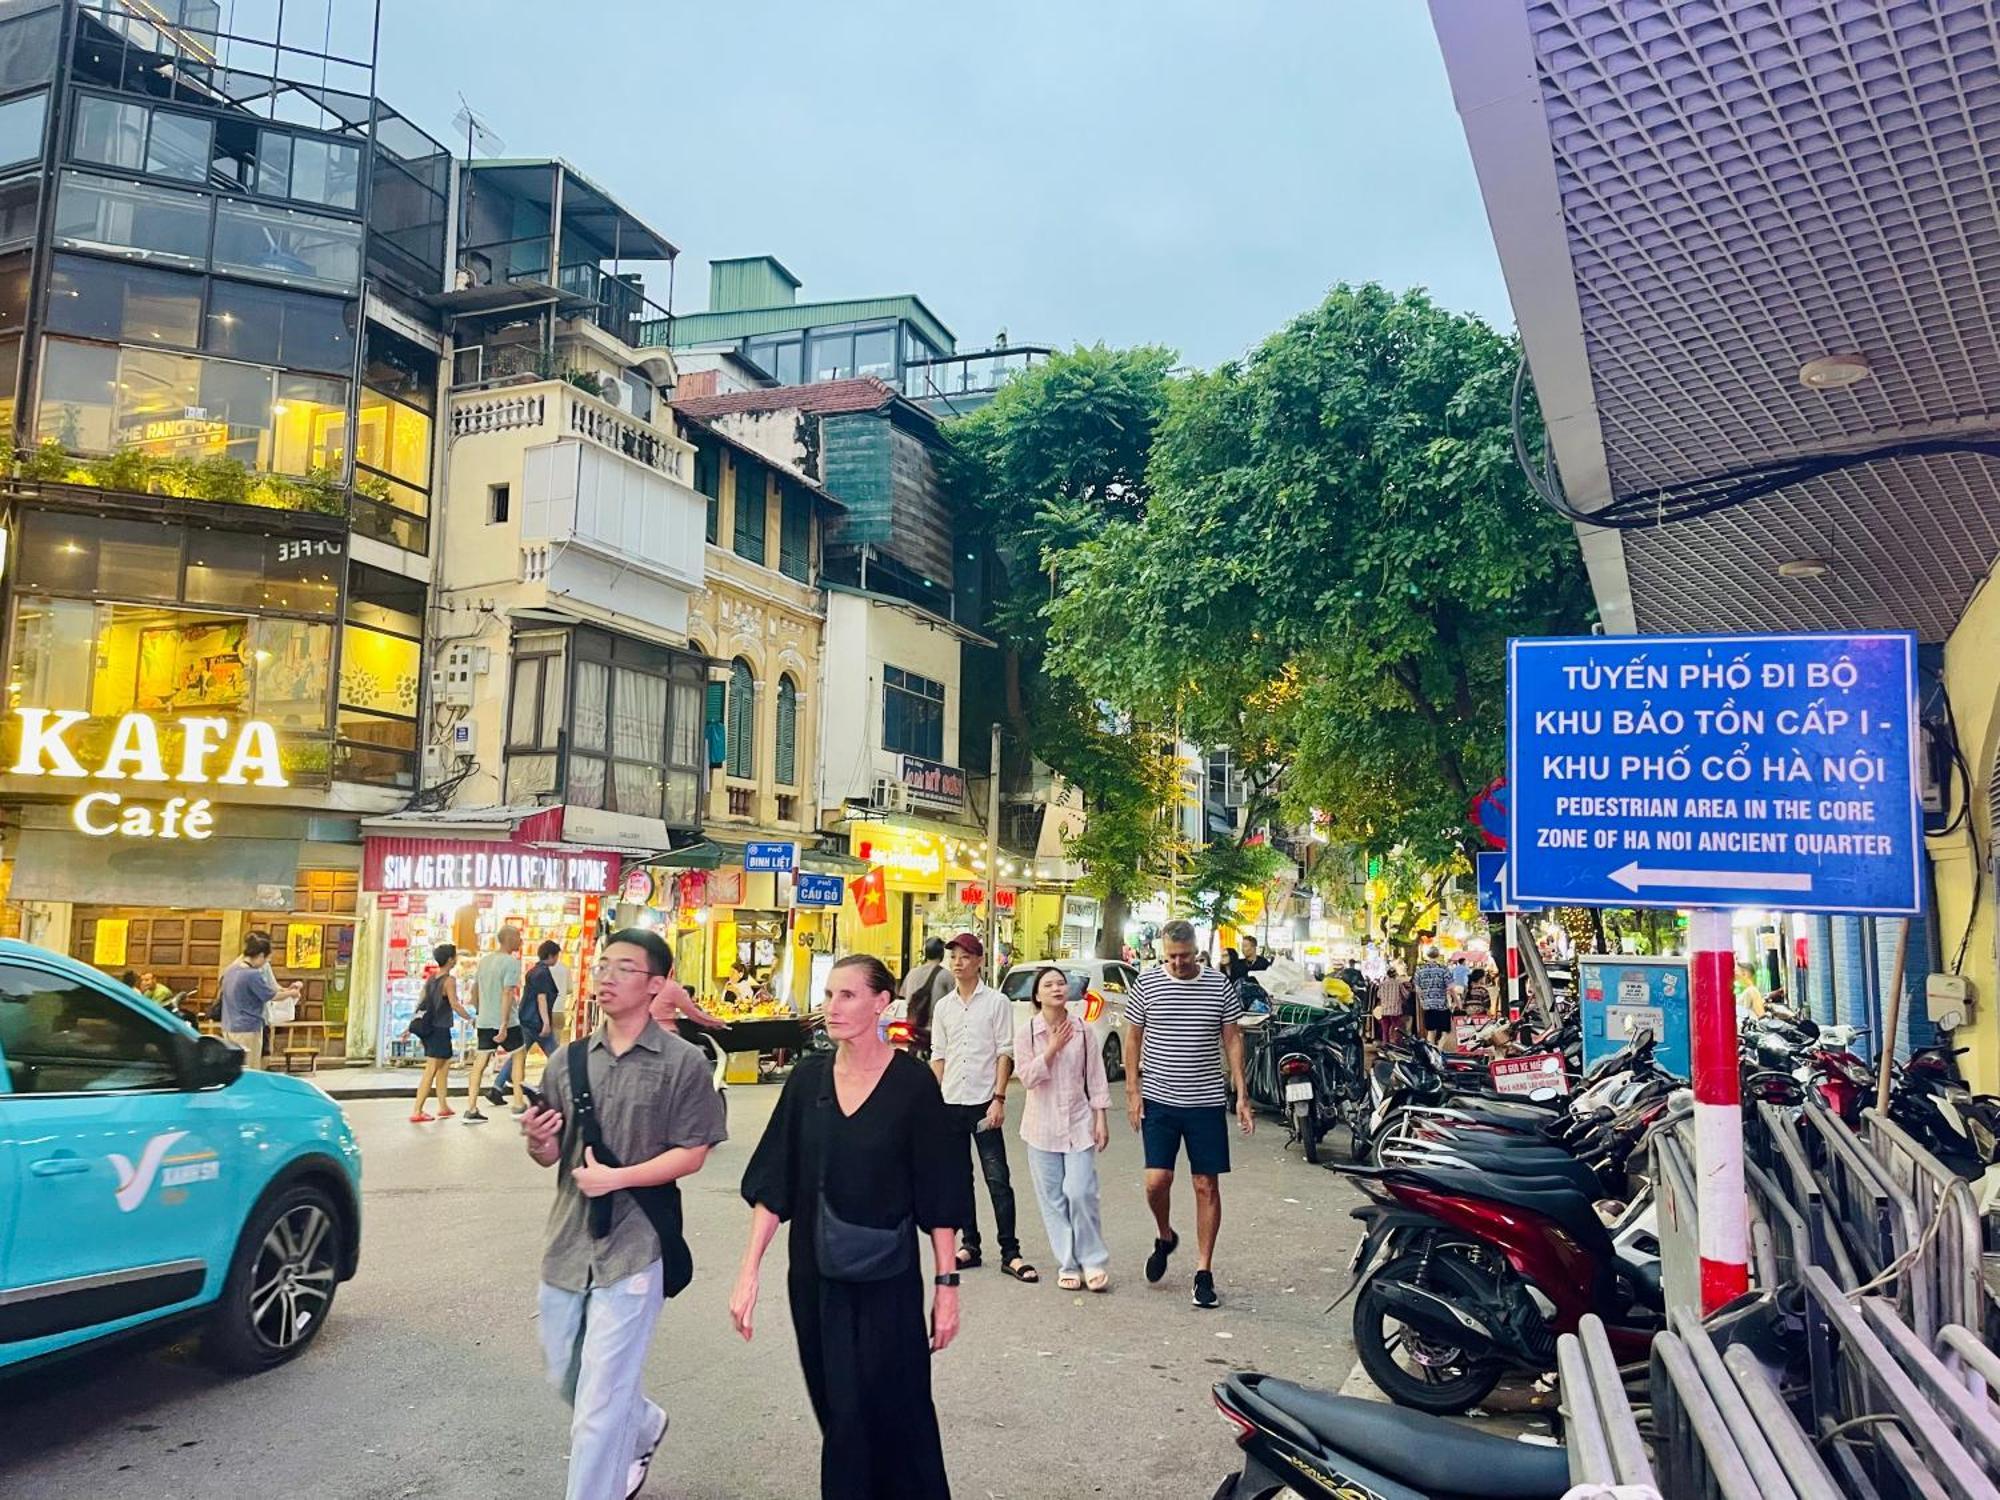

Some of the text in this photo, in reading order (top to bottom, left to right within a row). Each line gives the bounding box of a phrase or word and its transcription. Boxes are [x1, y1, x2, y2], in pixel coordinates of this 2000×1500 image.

[1680, 652, 1751, 690] PHỐ
[1761, 663, 1795, 688] ĐI
[1807, 655, 1858, 694] BỘ
[1535, 710, 1602, 735] KHU
[1613, 699, 1685, 735] BẢO
[1694, 697, 1764, 735] TỒN
[1776, 698, 1848, 735] CẤP
[1860, 709, 1868, 735] I
[10, 706, 290, 788] KAFA
[1543, 742, 1885, 790] KHU PHỐ CỔ HÀ NỘI
[72, 791, 214, 840] Café
[1556, 796, 1876, 822] PEDESTRIAN AREA IN THE CORE
[1537, 828, 1893, 856] ZONE OF HA NOI ANCIENT QUARTER
[384, 854, 412, 890] SIM
[414, 854, 434, 889] 4G
[435, 853, 472, 888] FREE
[474, 852, 518, 888] DATA
[568, 858, 608, 892] PHONE
[798, 932, 814, 947] 96
